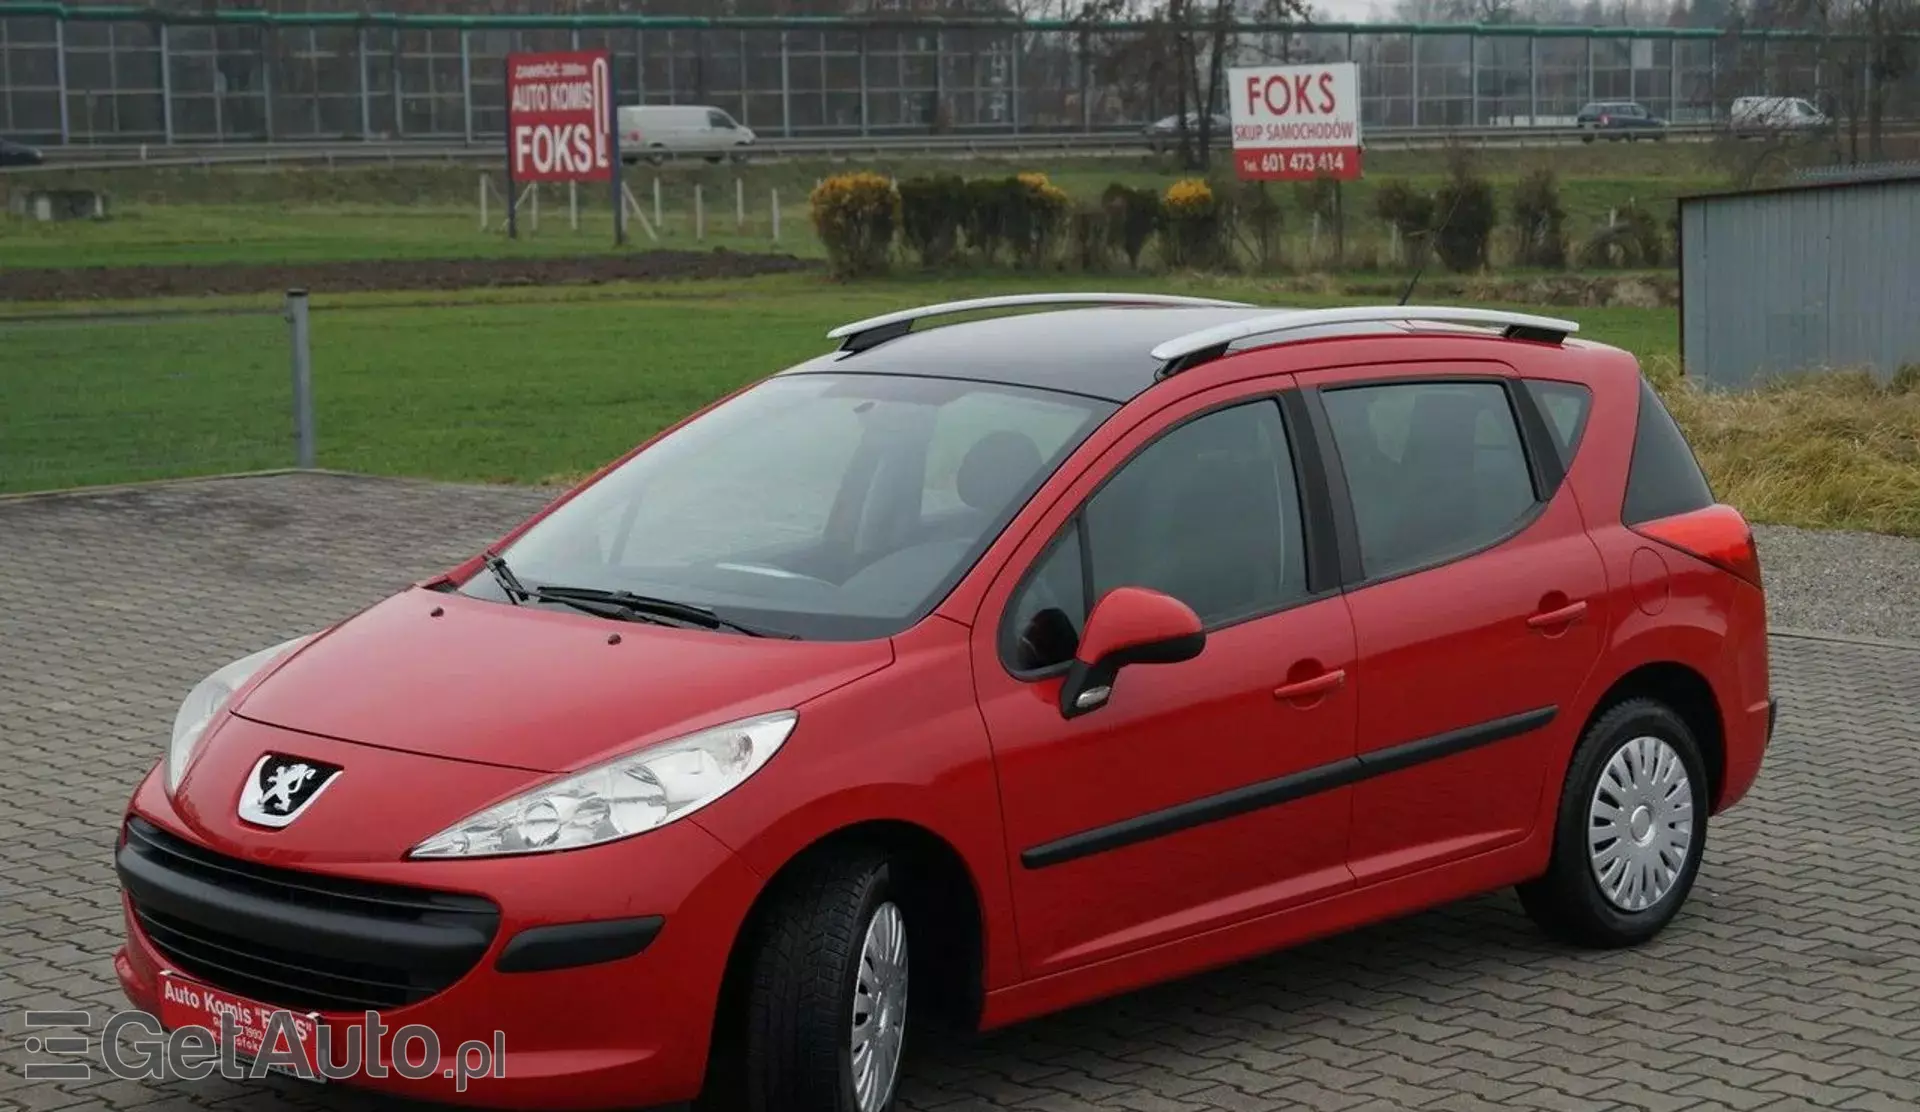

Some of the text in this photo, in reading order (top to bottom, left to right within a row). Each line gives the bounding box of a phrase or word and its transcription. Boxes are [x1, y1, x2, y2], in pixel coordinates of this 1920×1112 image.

[512, 82, 593, 111] AUTO KOMIS
[1247, 72, 1336, 116] FOKS
[1235, 117, 1354, 140] SKUP SAMOCHODÓW
[515, 123, 593, 173] FOKS
[1261, 153, 1285, 172] 601
[1290, 153, 1314, 171] 473
[164, 980, 199, 1008] Auto
[204, 991, 252, 1025] Komis
